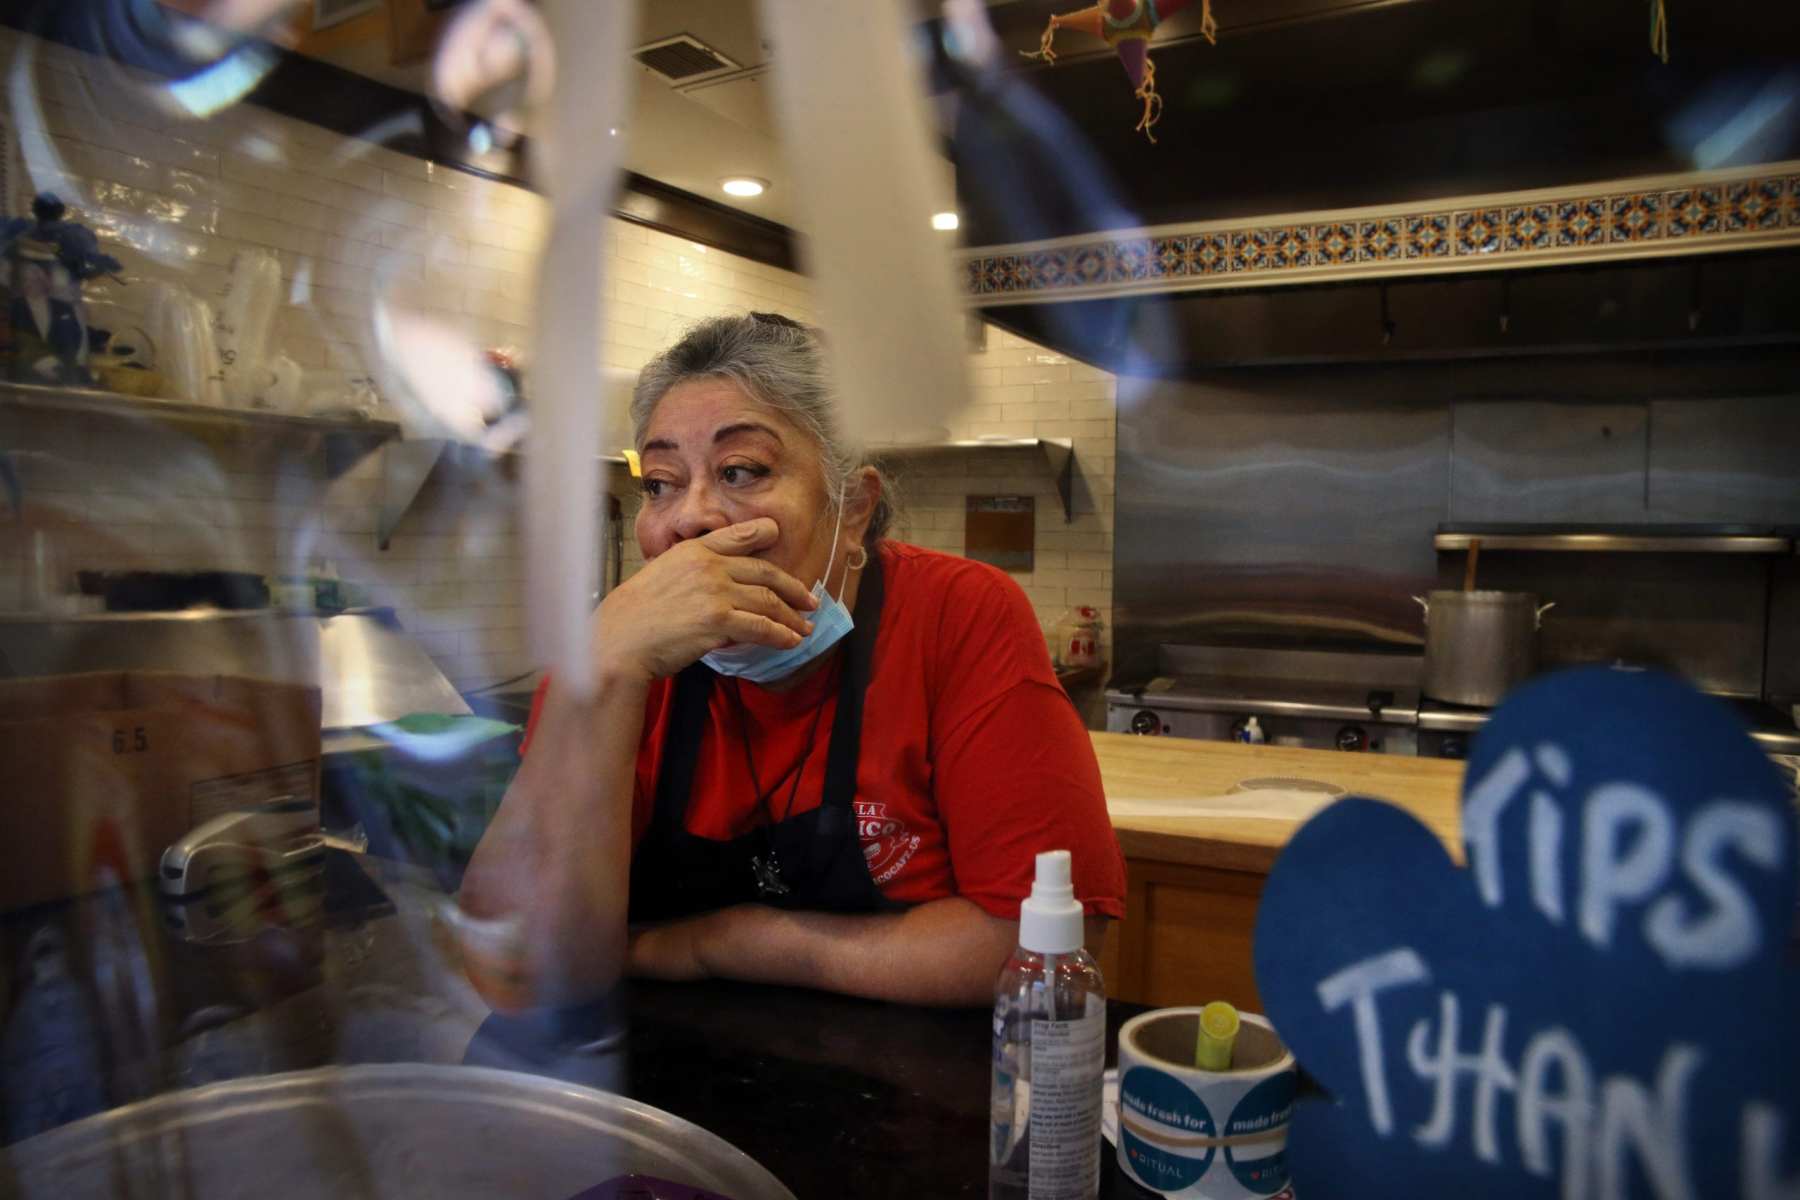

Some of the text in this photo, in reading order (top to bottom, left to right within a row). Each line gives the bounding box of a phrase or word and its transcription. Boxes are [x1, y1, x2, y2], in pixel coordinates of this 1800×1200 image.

[1147, 1105, 1182, 1123] fresh
[1183, 1113, 1207, 1129] for
[1233, 1114, 1270, 1131] made
